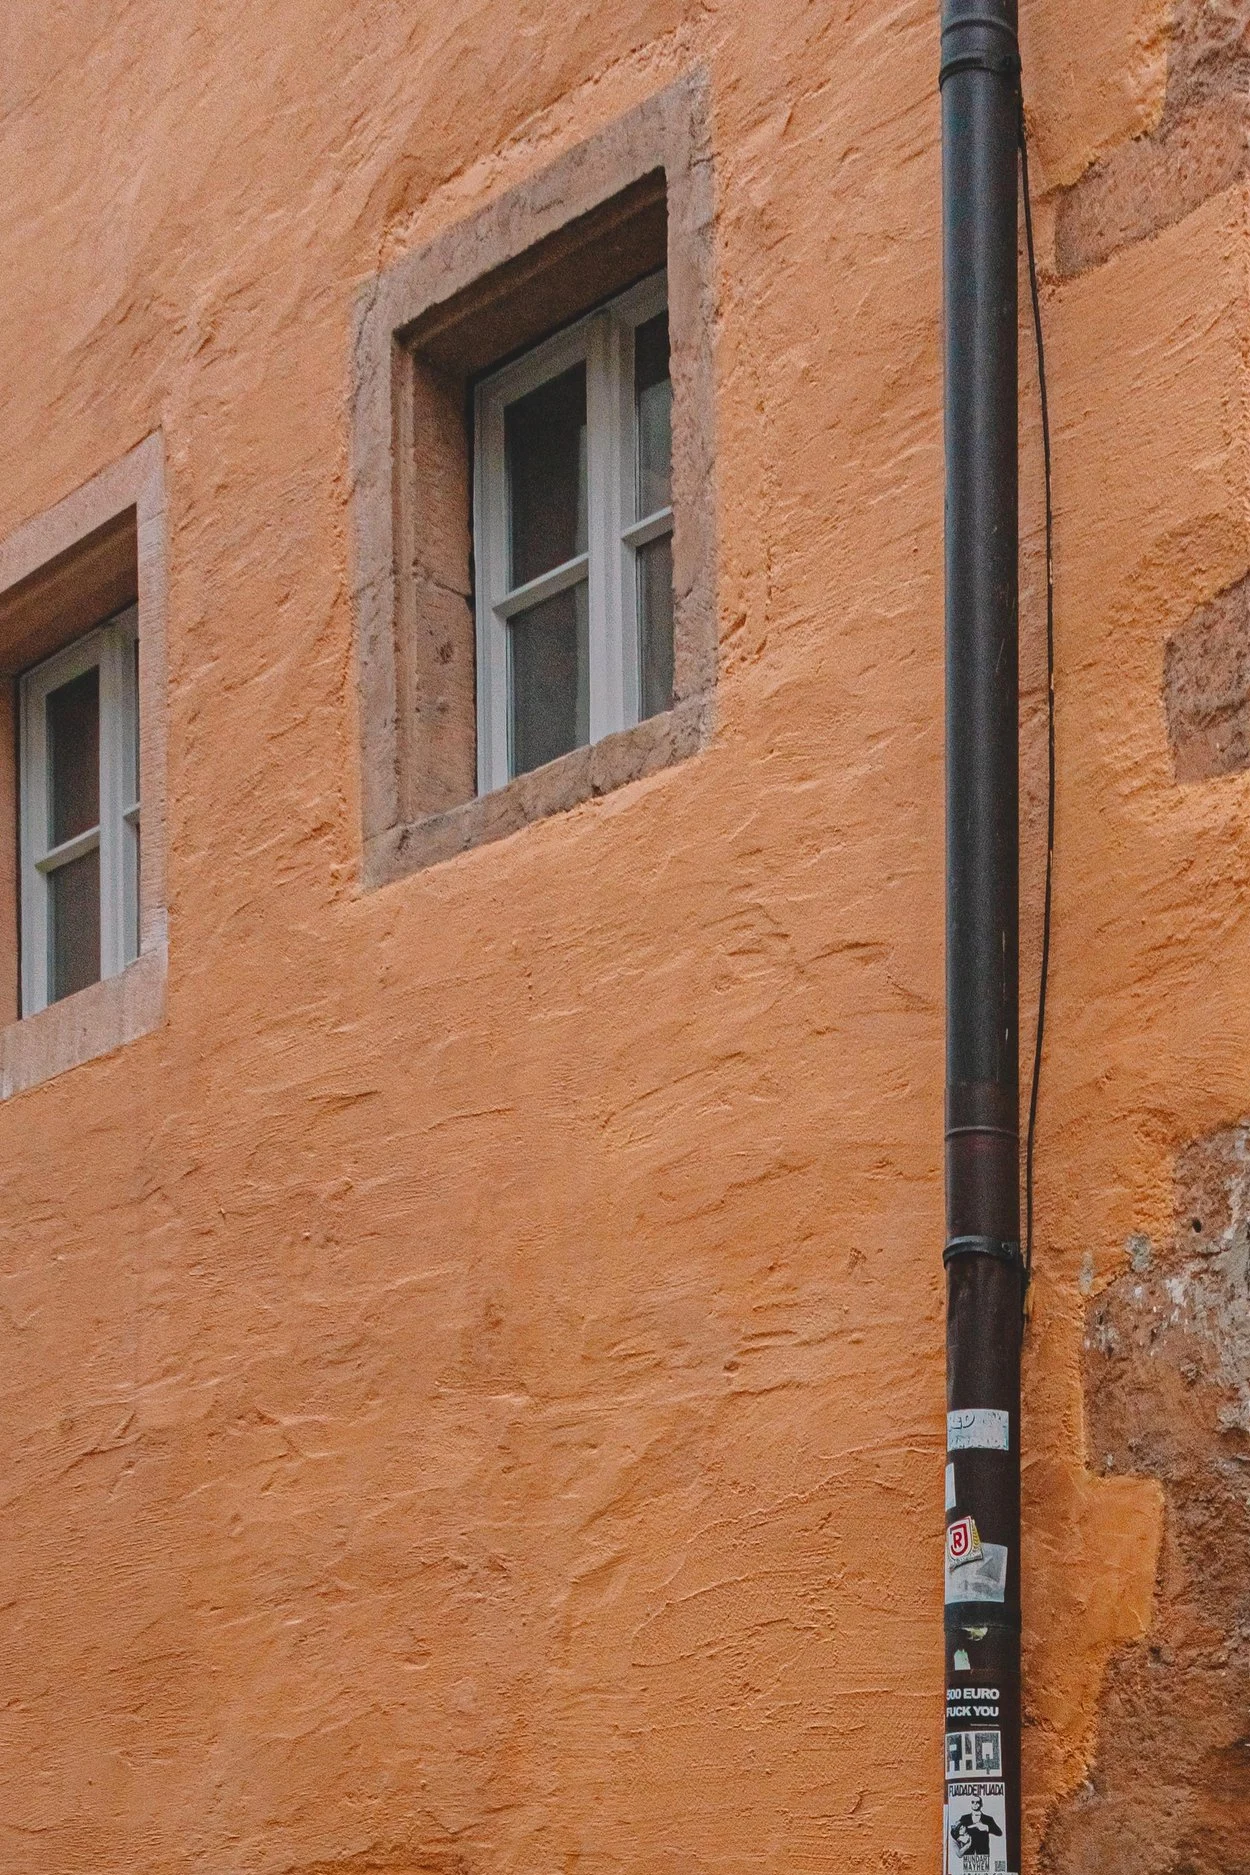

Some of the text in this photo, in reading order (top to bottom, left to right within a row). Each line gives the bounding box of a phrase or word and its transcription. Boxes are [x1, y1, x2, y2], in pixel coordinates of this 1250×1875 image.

[963, 1688, 1000, 1700] EURO
[946, 1706, 999, 1717] FUCK YOU
